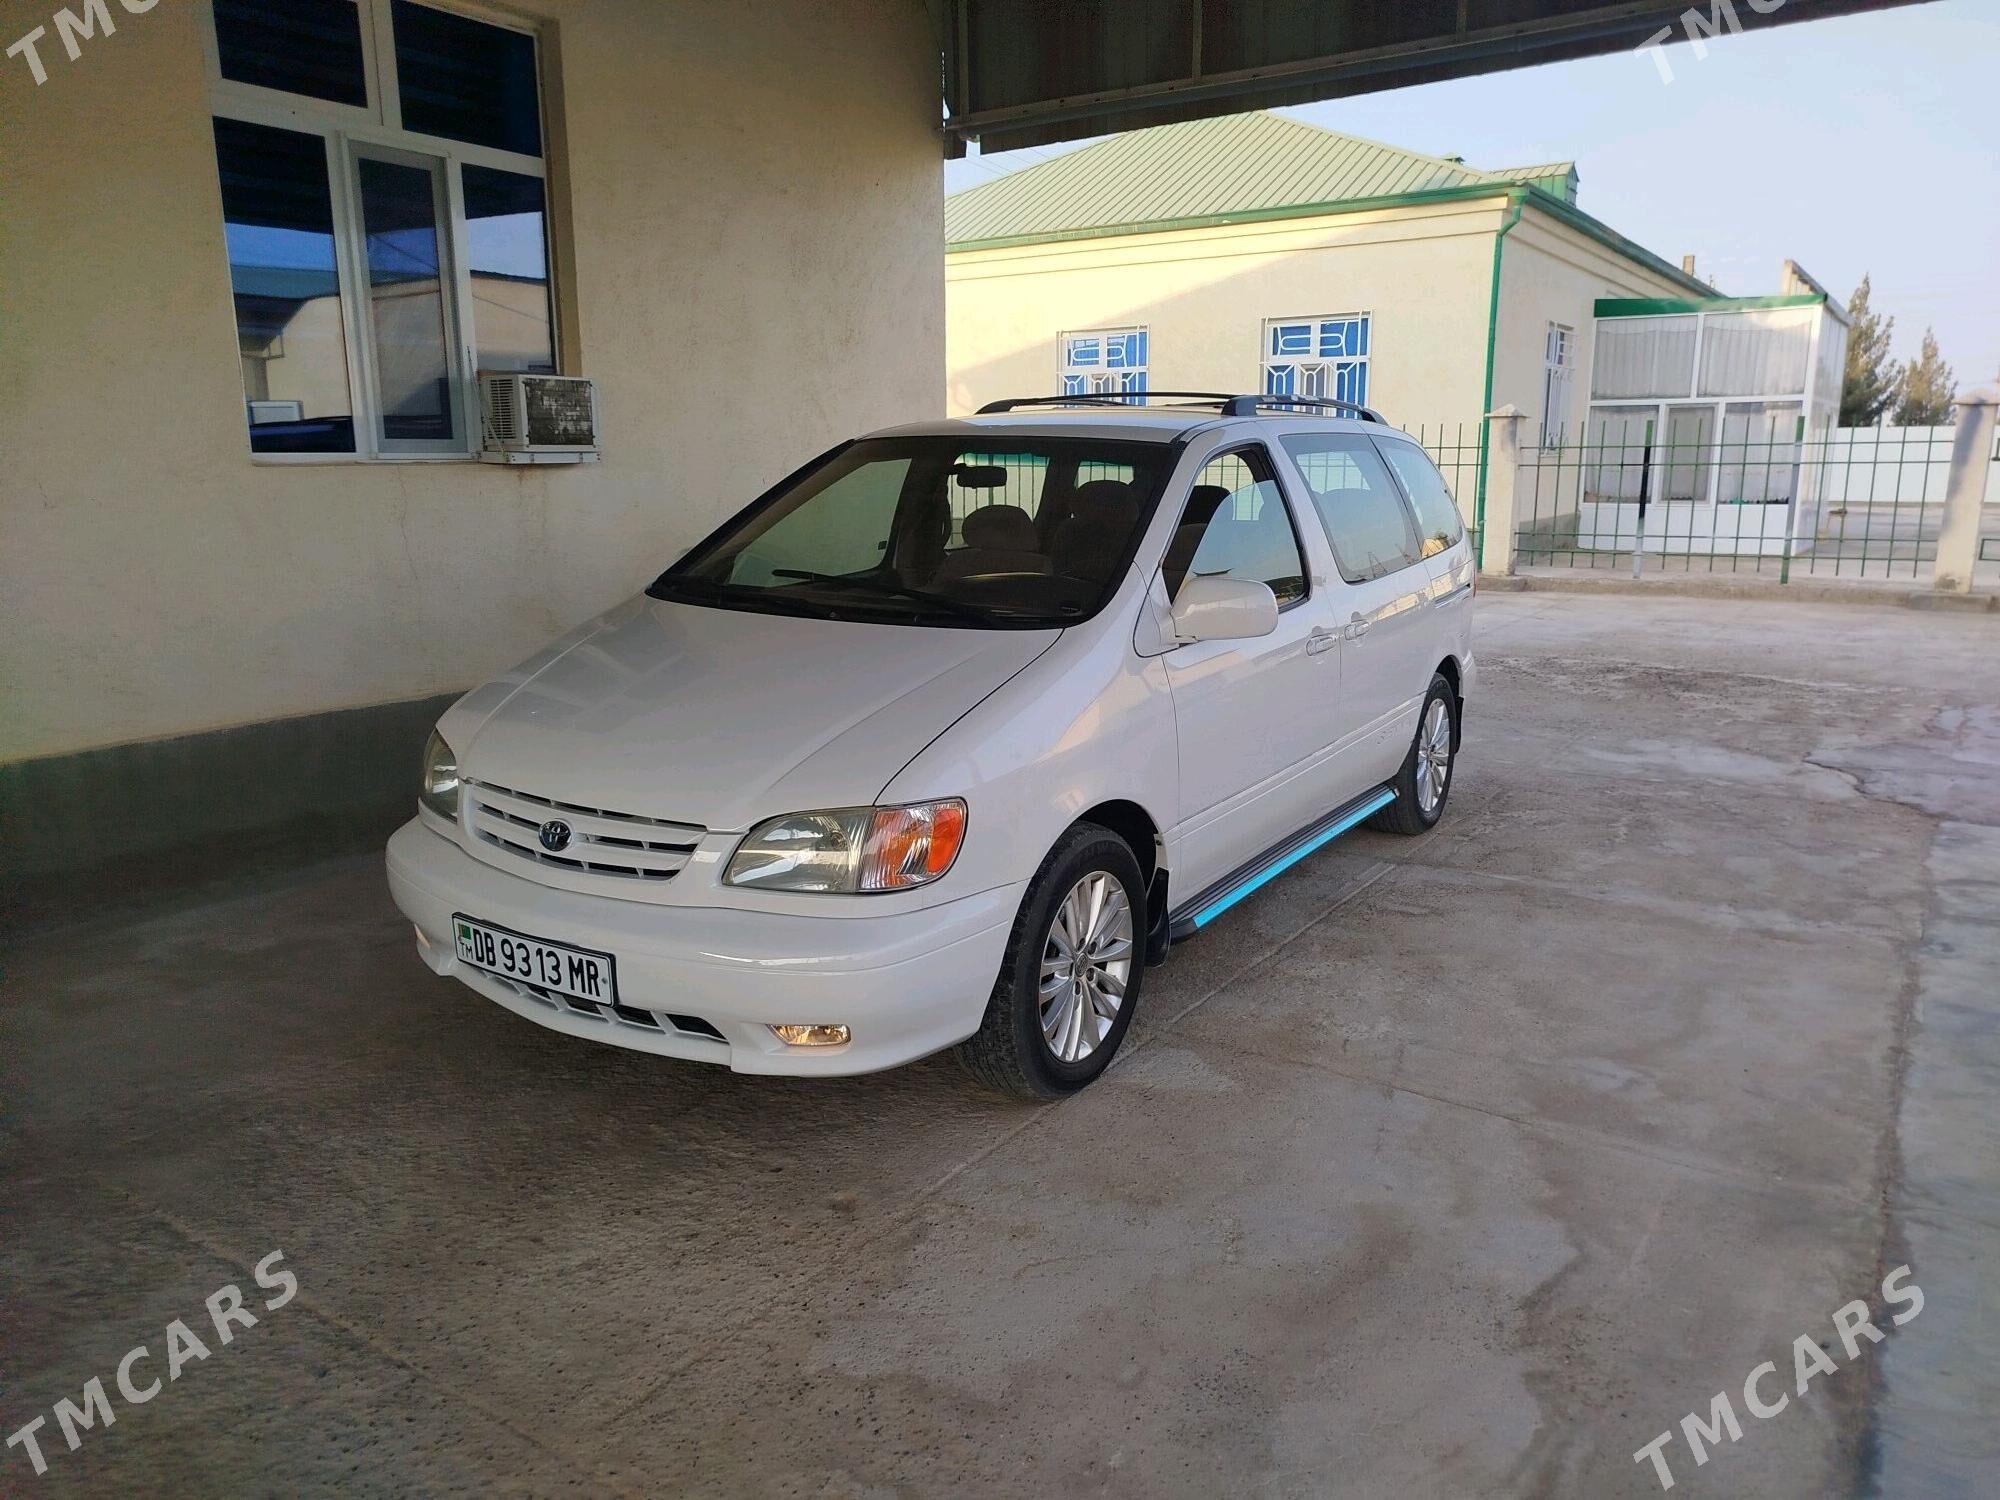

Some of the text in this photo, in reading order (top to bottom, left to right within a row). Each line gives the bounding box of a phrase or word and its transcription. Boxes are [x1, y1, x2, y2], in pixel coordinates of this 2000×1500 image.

[473, 929, 600, 996] DB 9313 MR
